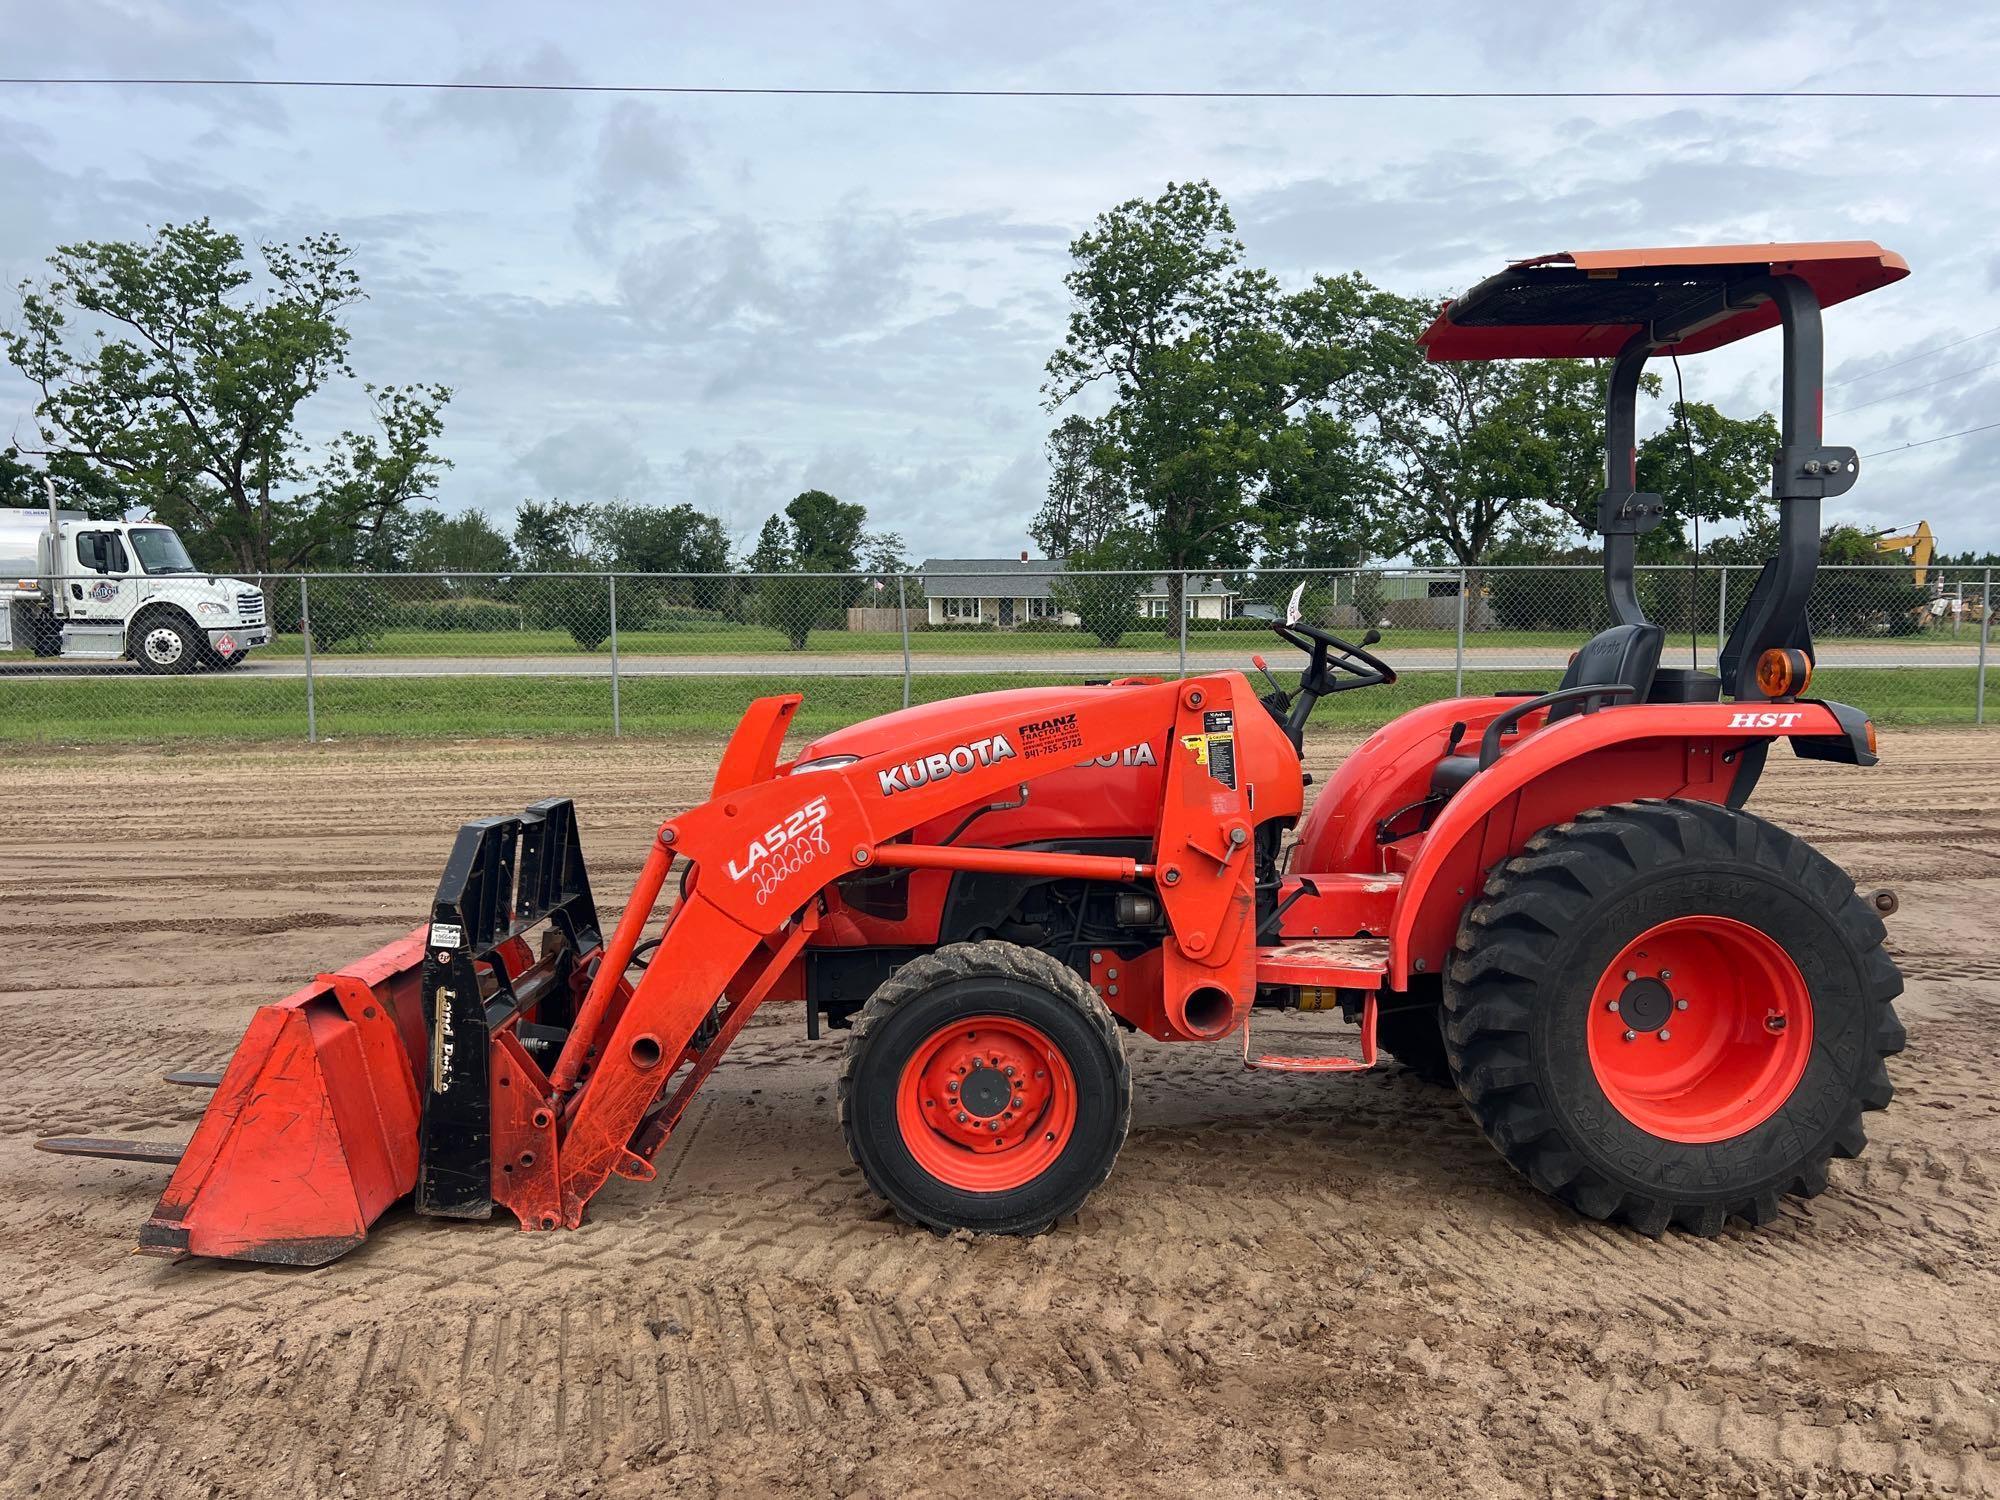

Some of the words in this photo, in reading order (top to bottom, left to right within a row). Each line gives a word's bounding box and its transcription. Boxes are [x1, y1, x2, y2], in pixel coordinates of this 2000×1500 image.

[88, 588, 106, 599] Hall
[107, 586, 119, 596] Oil
[1019, 713, 1077, 735] FRANZ
[1727, 712, 1802, 728] HST
[1021, 727, 1061, 741] TRACTOR
[1063, 723, 1078, 731] CO.
[1024, 738, 1083, 759] 941-755-5722
[878, 734, 1017, 796] KUBOTA
[728, 795, 827, 881] LA525
[751, 823, 830, 906] 222228
[441, 989, 457, 1037] Land
